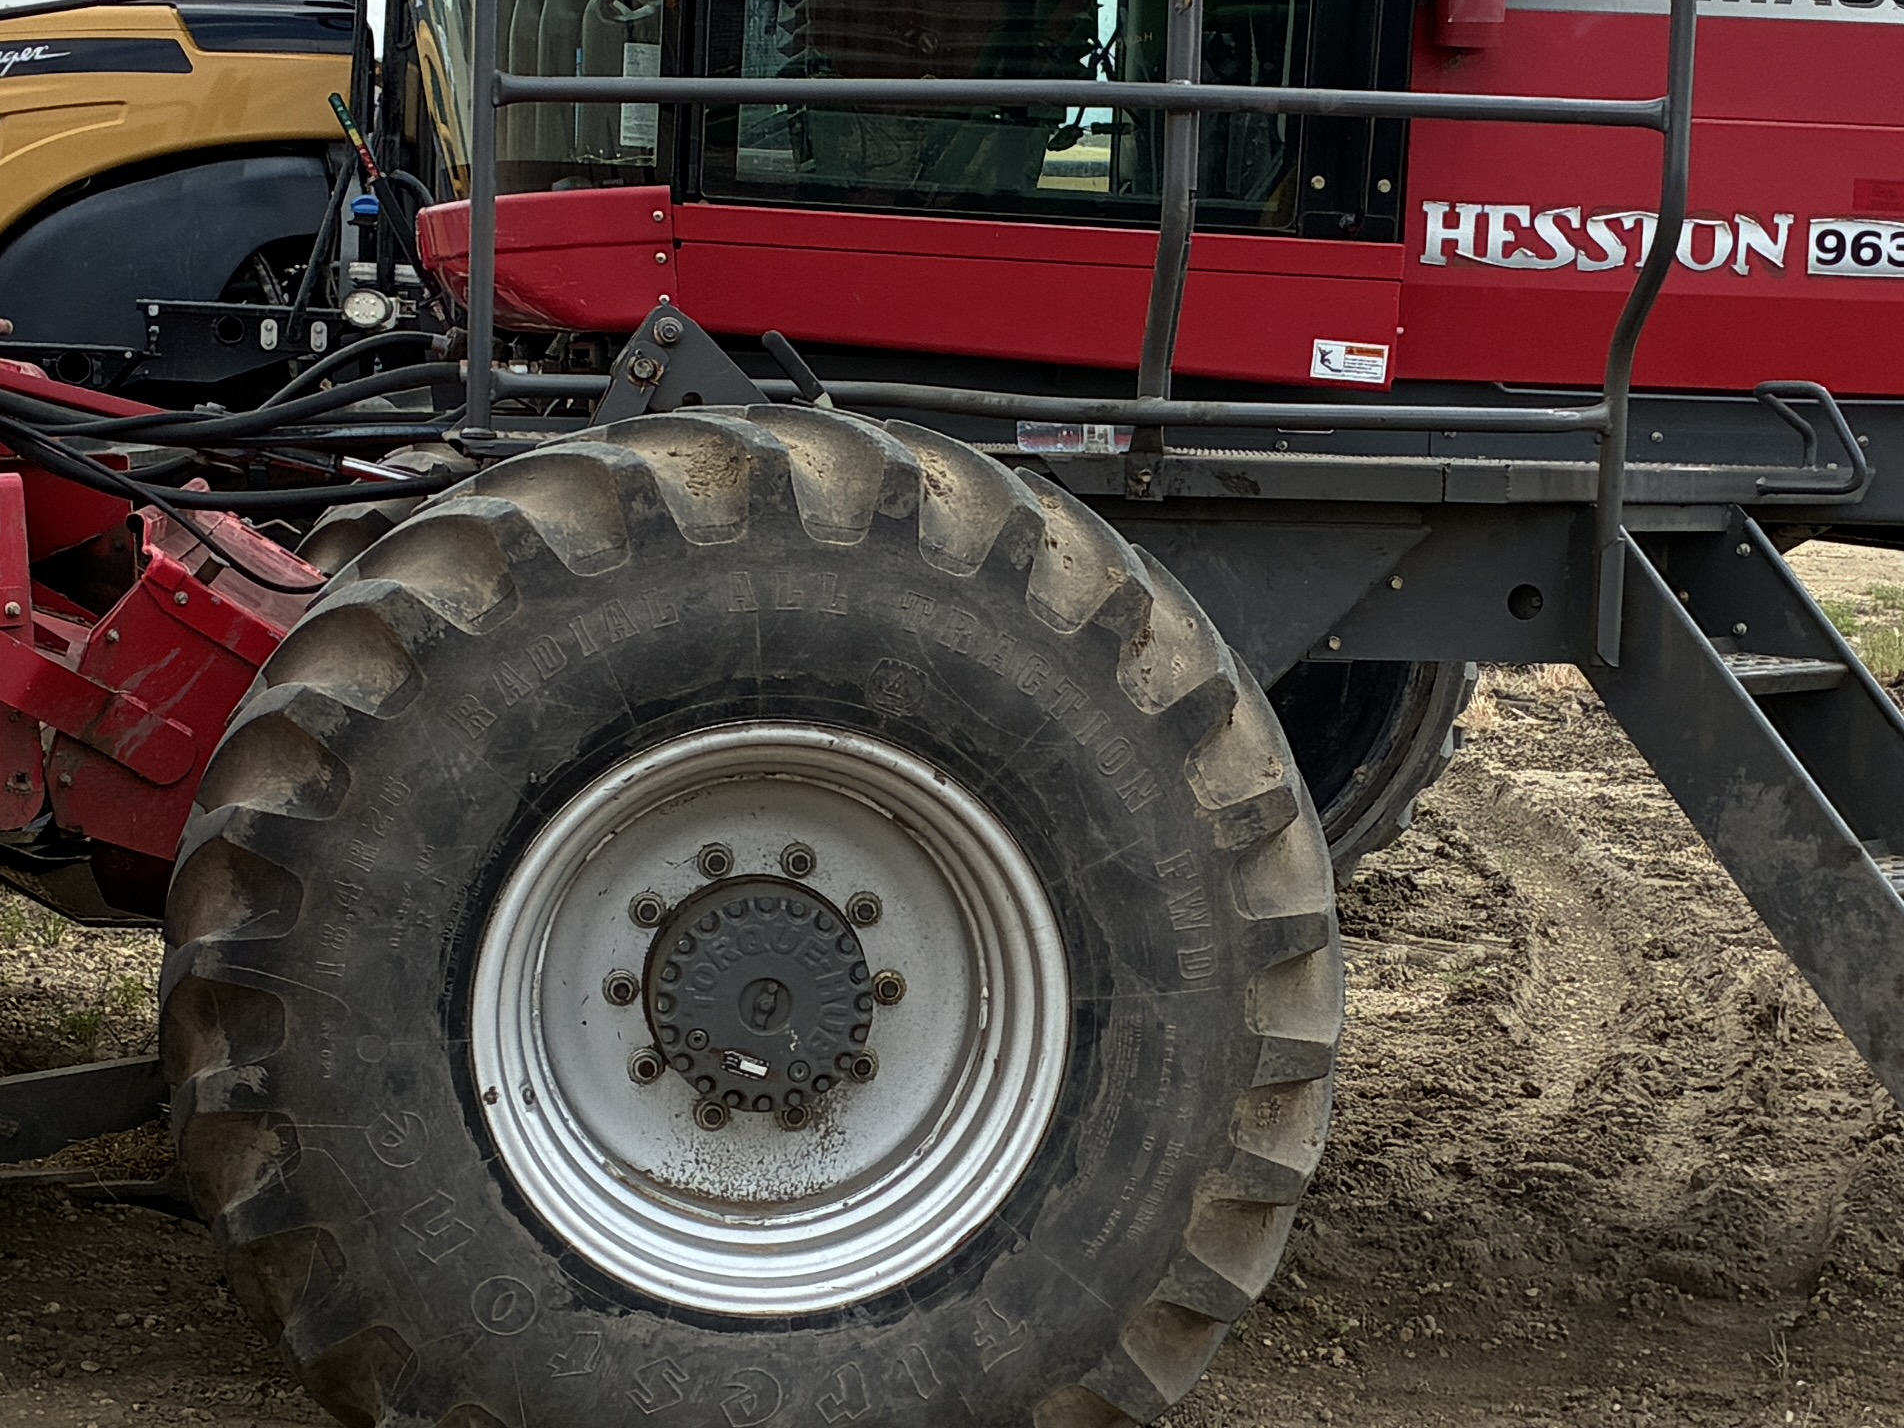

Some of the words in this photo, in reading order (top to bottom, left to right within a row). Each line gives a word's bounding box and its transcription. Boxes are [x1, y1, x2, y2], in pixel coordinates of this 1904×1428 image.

[1419, 200, 1795, 276] HESSTON
[445, 588, 680, 740] RADIAL
[727, 571, 849, 616] ALL
[899, 589, 1166, 814] TRACTION
[1155, 848, 1217, 982] FWD
